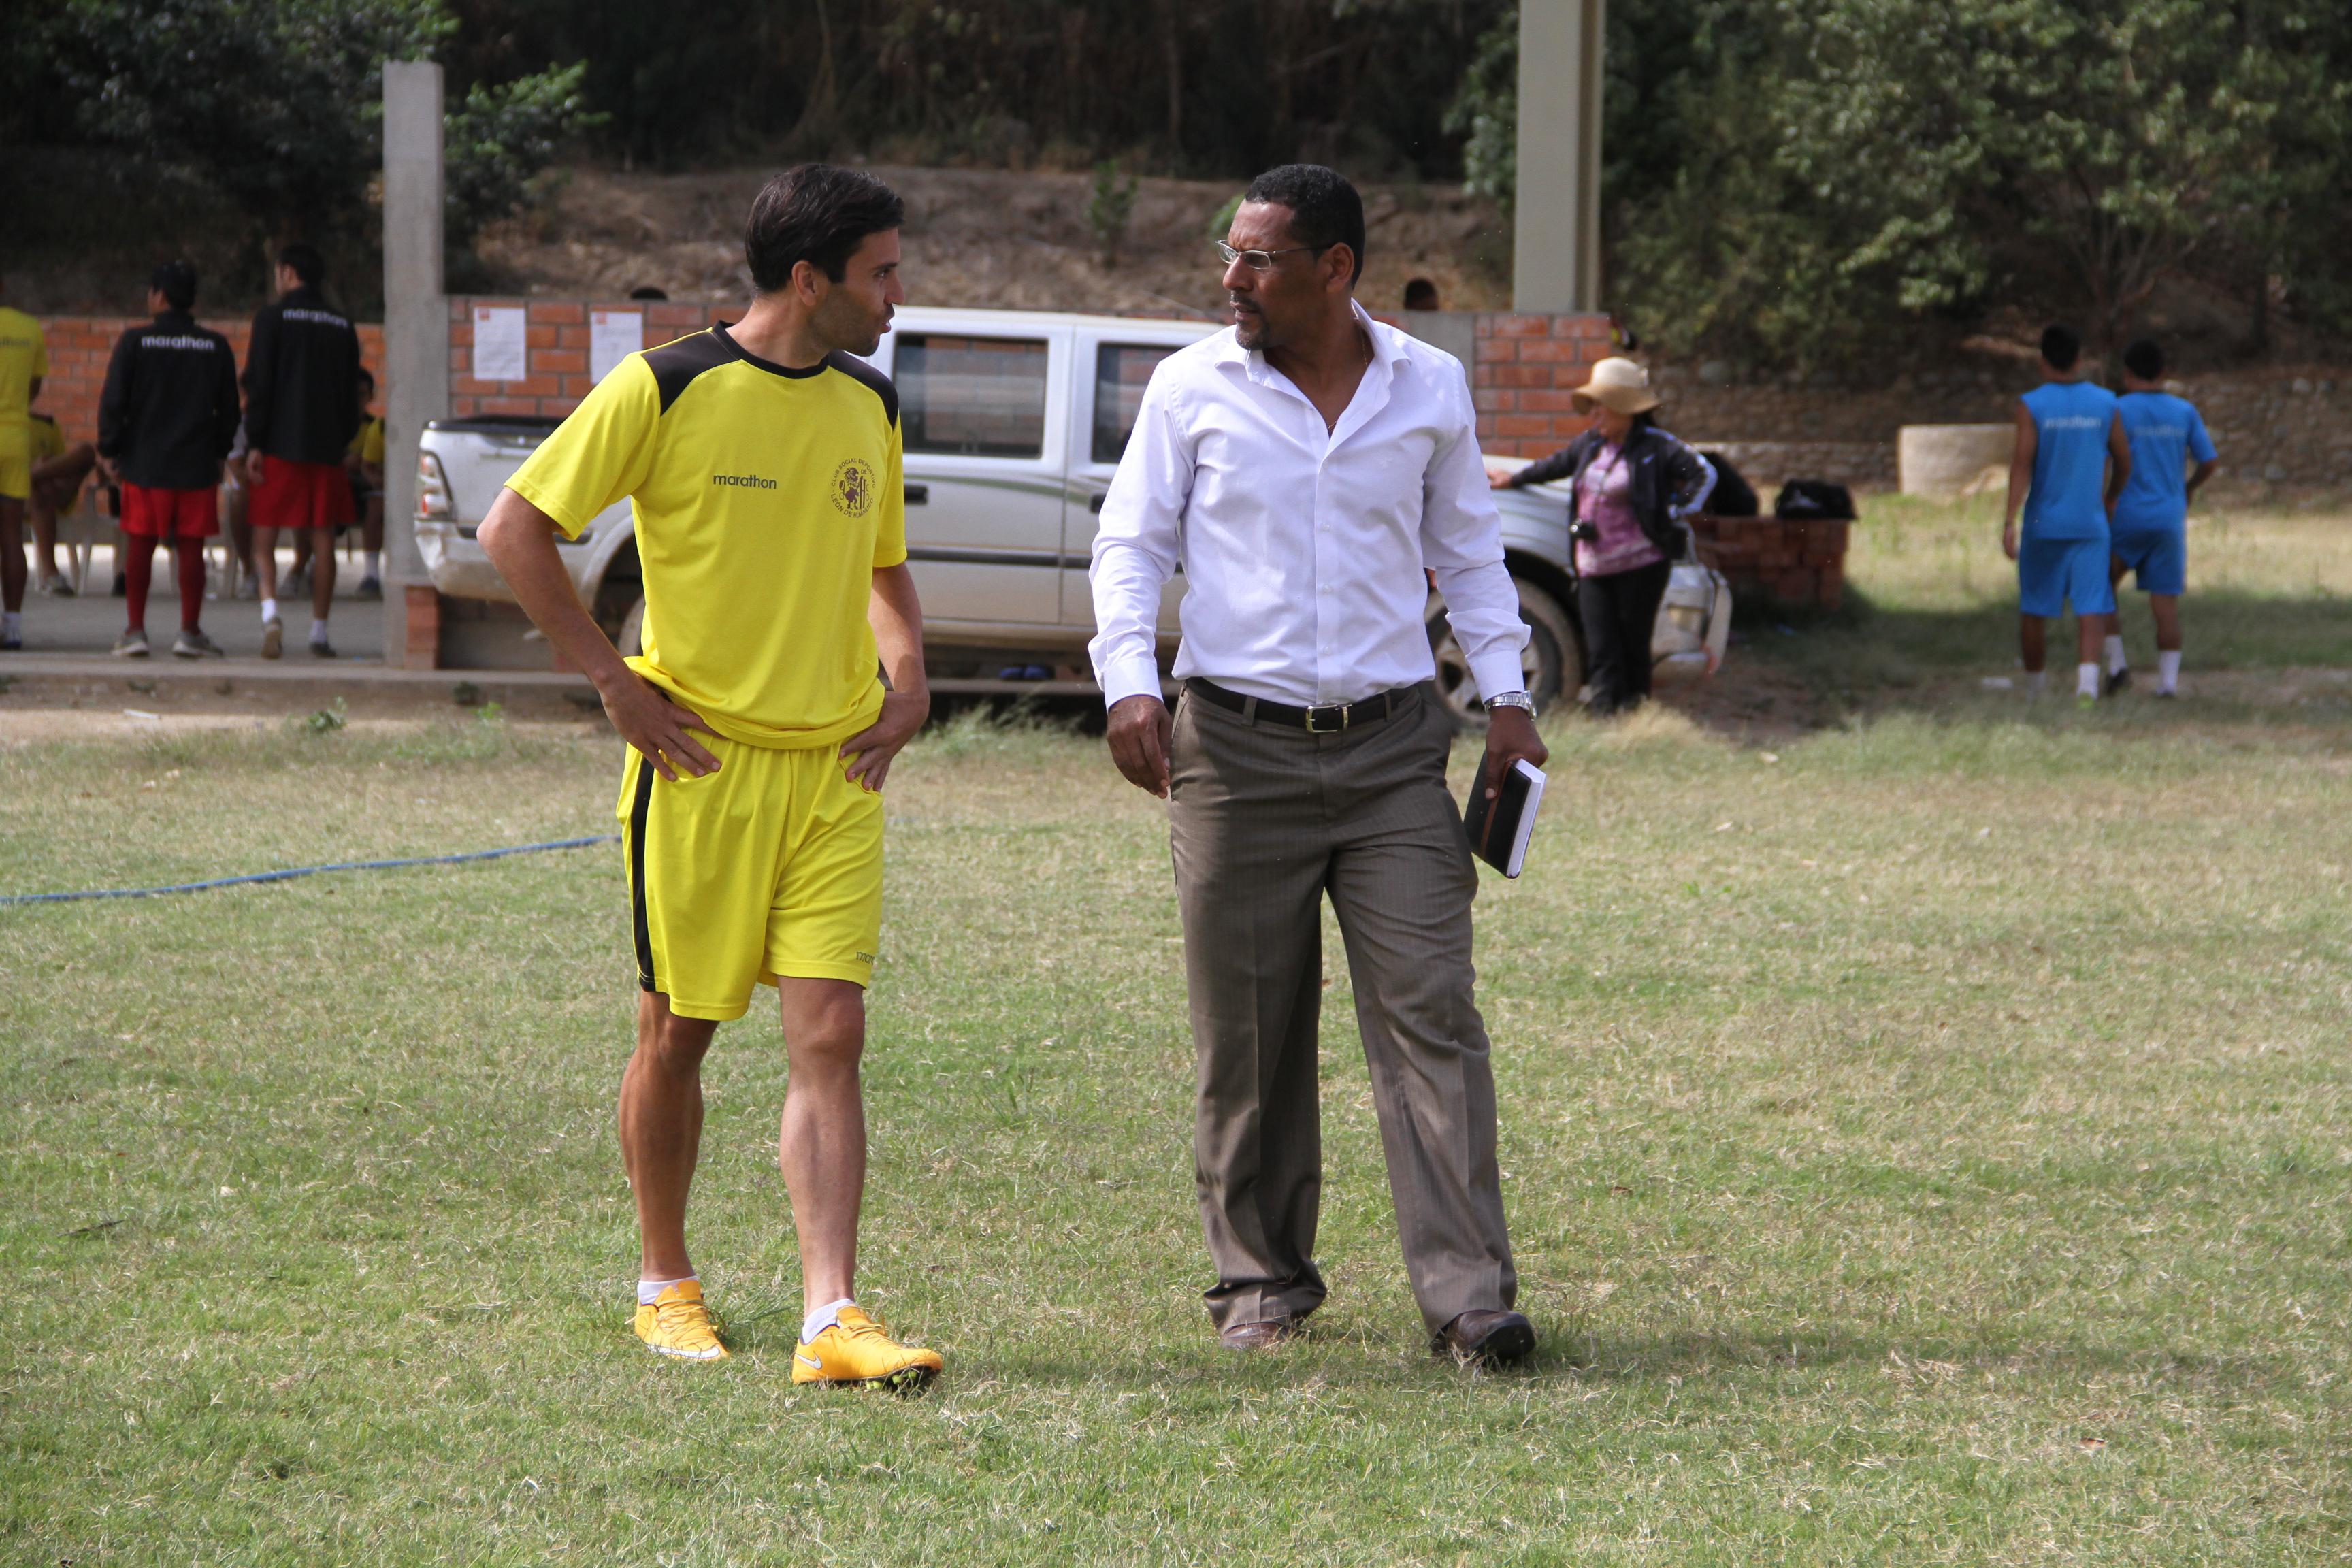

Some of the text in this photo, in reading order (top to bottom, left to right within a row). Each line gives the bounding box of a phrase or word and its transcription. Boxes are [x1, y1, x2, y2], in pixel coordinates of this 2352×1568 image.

[141, 334, 215, 350] marathon
[831, 458, 876, 489] CLUB SOCIAL DEPORTIVO
[713, 474, 777, 489] marathon
[843, 509, 853, 517] DE
